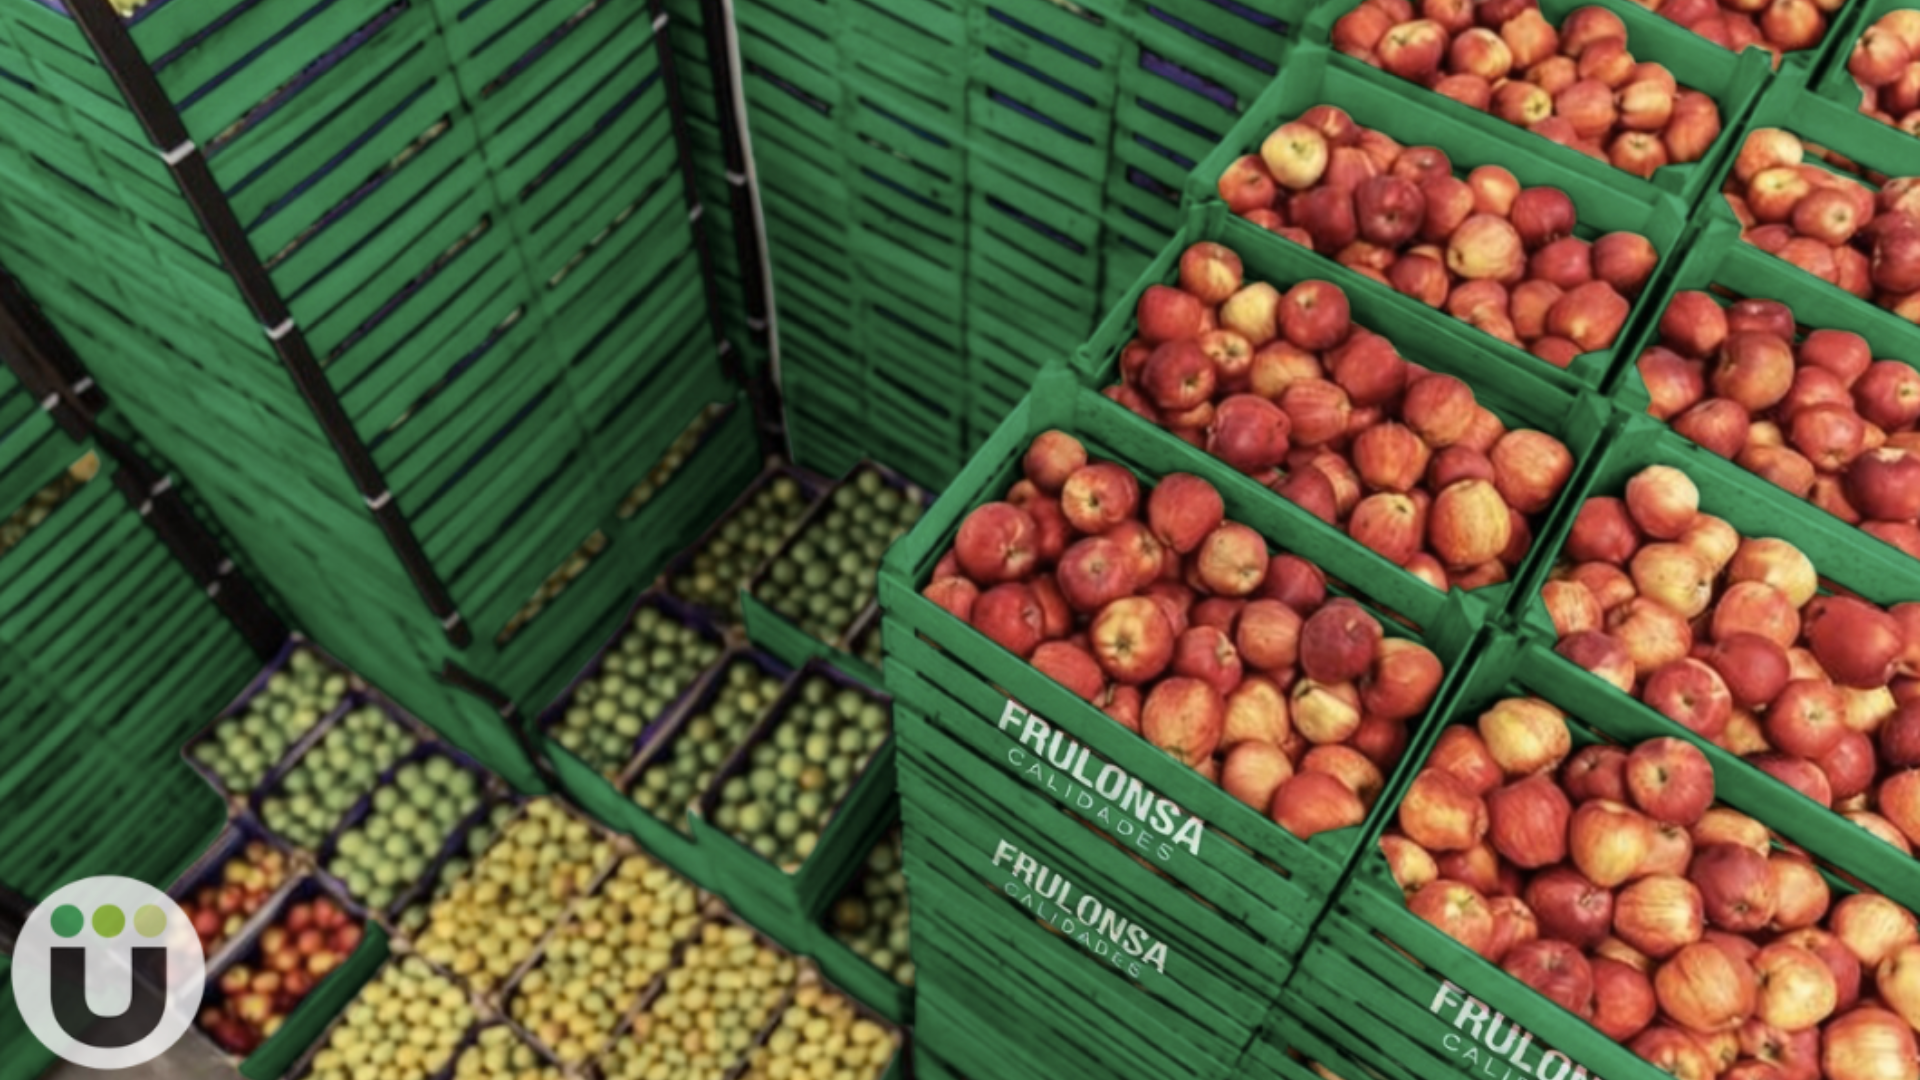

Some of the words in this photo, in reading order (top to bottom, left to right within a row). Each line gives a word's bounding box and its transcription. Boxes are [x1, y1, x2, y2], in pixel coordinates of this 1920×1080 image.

[998, 699, 1204, 855] FRULONSA
[1008, 749, 1173, 860] CALIDADES
[992, 839, 1168, 973] FRULONSA
[1442, 1034, 1528, 1080] CALI
